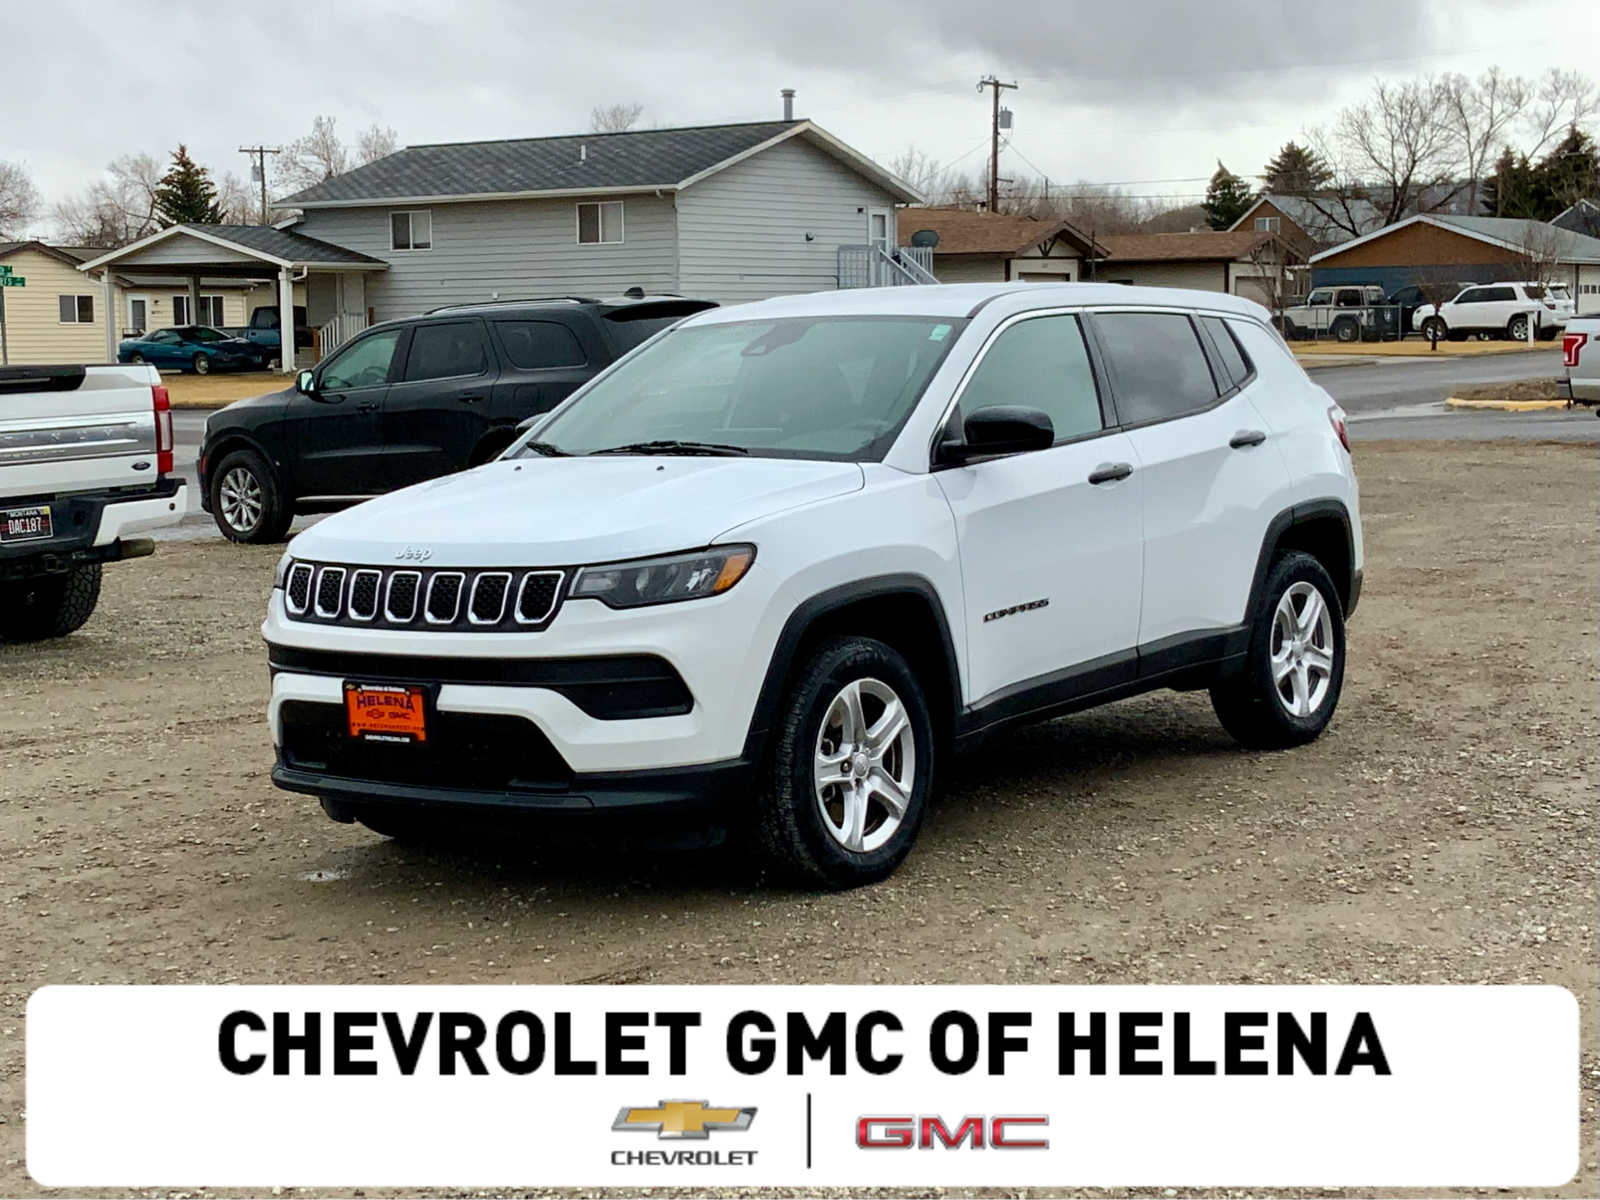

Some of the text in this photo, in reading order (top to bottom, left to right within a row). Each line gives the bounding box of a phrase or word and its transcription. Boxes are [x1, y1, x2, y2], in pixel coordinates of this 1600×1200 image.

[8, 517, 41, 534] DAC187
[393, 545, 432, 563] Jeep
[983, 598, 1049, 623] COMPASS
[357, 695, 416, 713] HELENA
